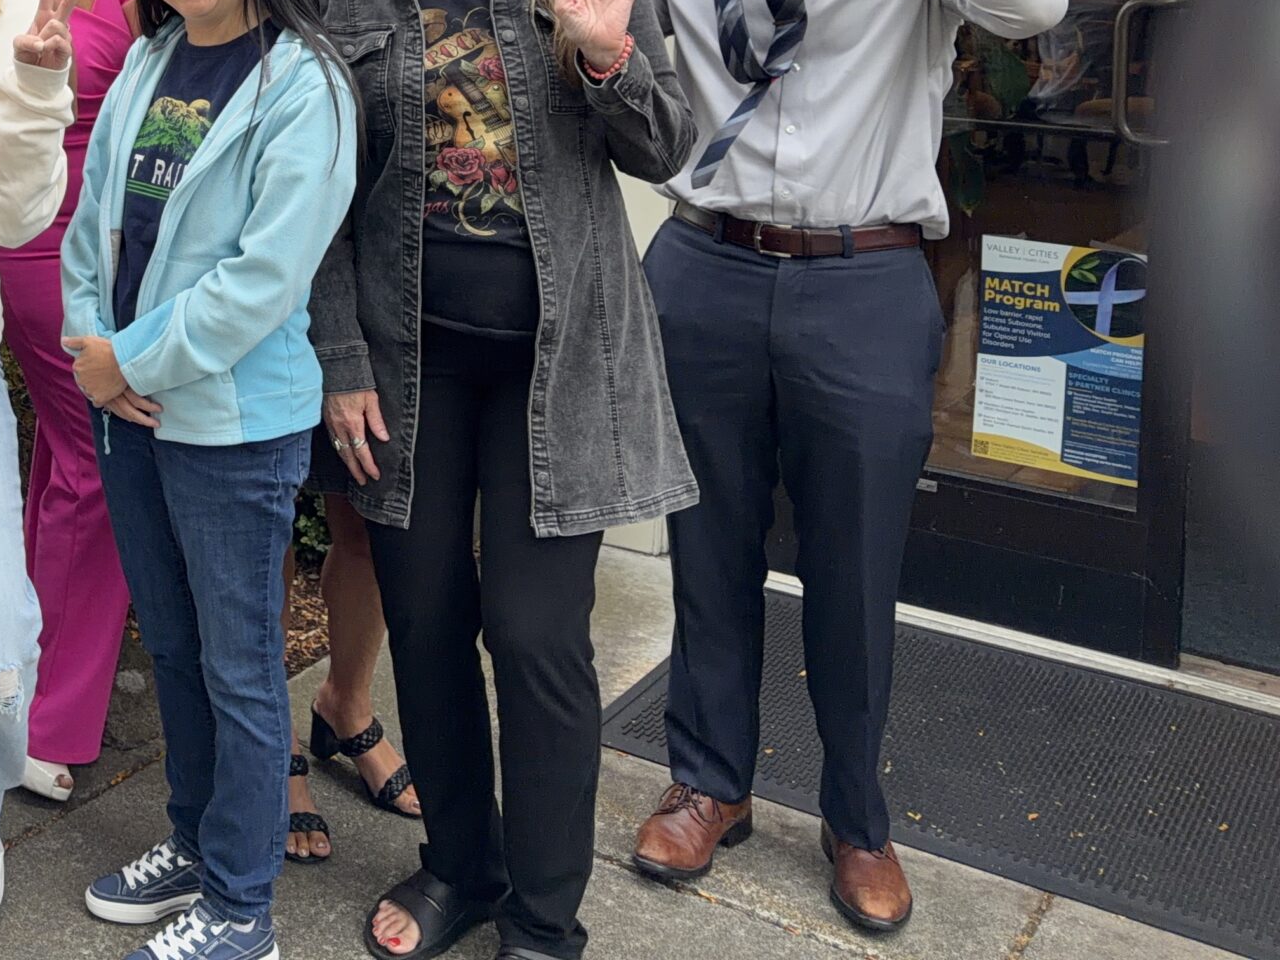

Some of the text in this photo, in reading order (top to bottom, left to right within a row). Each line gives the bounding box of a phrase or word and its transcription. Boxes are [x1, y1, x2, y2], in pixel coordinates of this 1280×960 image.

[150, 158, 188, 189] RAI
[986, 243, 1059, 259] VALLEY CITIES
[985, 277, 1050, 298] MATCH
[984, 289, 1061, 312] Program
[983, 307, 998, 315] Low
[983, 316, 1006, 324] access
[1011, 327, 1025, 335] and
[982, 338, 1015, 349] Disorders
[1018, 336, 1032, 344] Use
[980, 357, 1041, 373] OUR LOCATIONS
[1068, 372, 1109, 384] SPECIALTY
